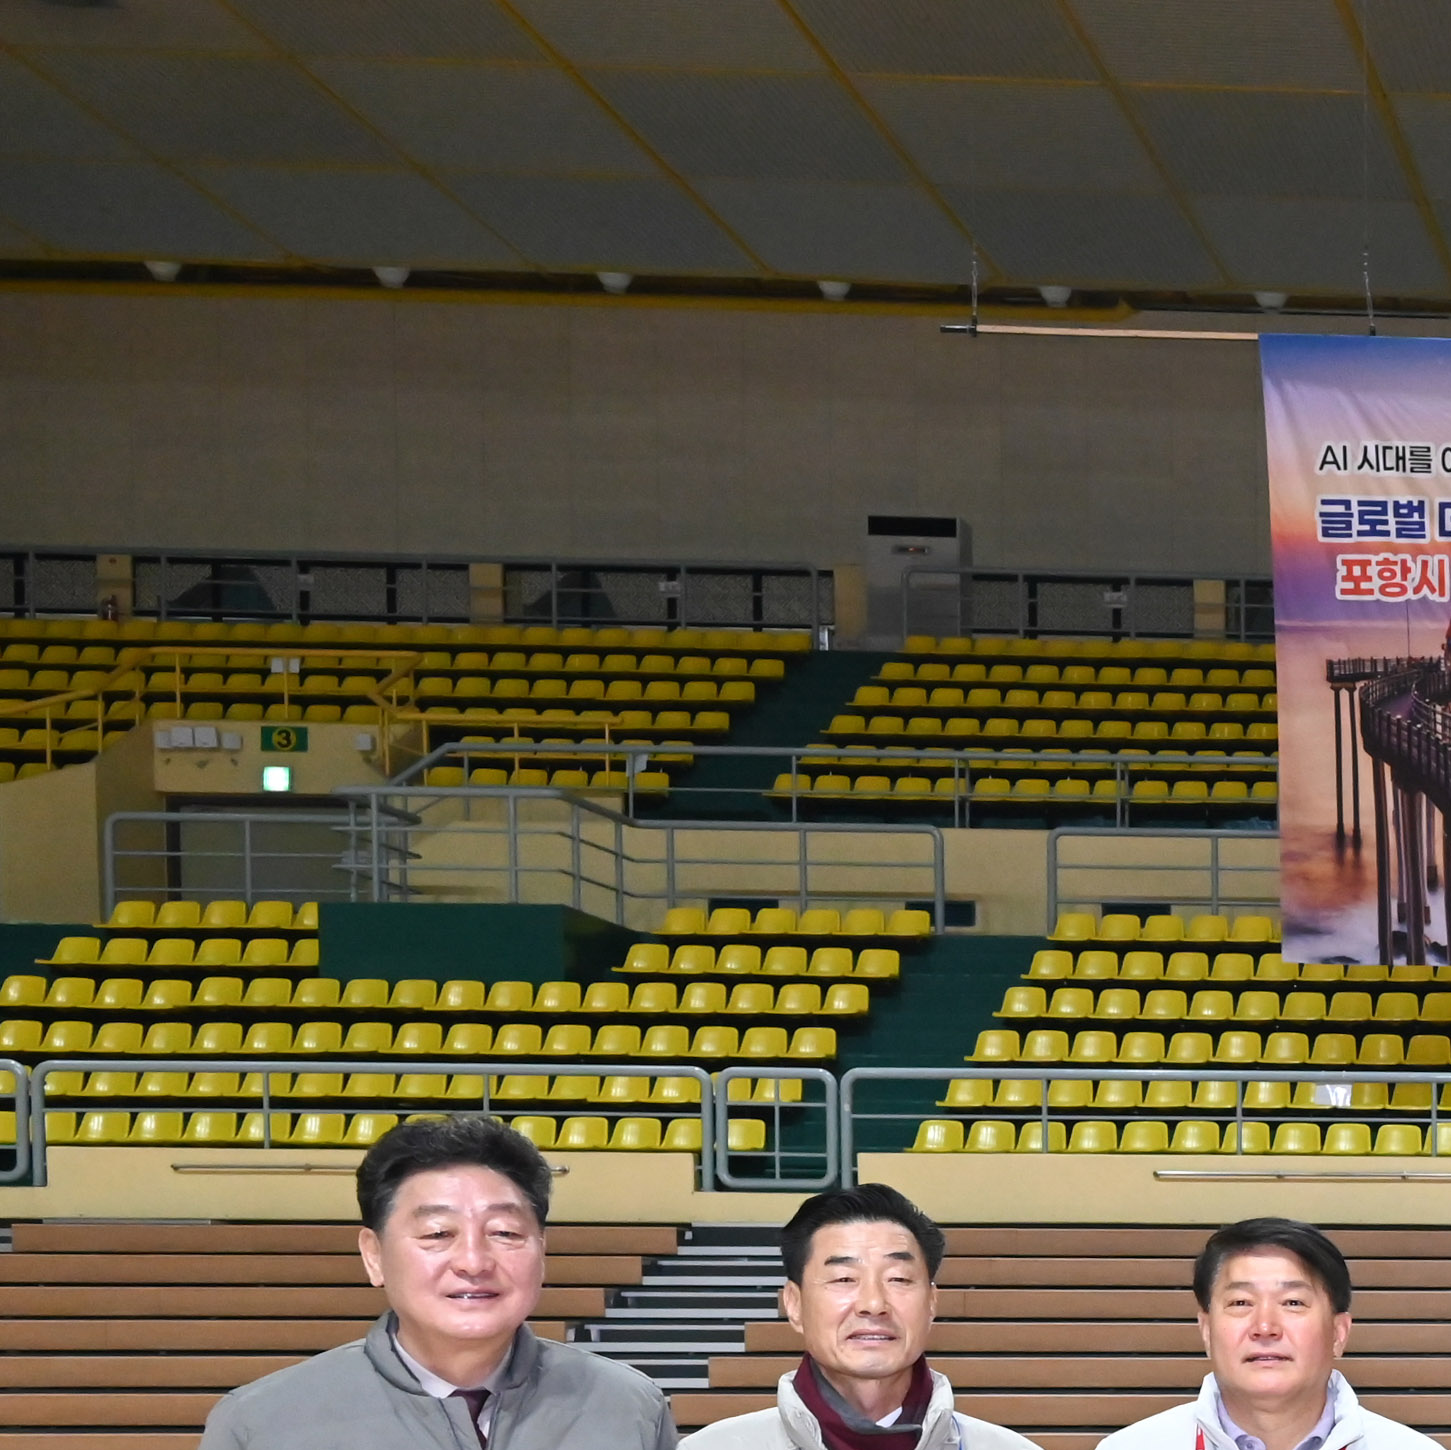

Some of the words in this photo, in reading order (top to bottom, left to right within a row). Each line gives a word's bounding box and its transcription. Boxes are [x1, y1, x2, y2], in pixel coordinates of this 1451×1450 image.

[1319, 445, 1348, 471] AI
[1357, 445, 1433, 474] 시대를
[1318, 499, 1427, 539] 글로벌
[1339, 557, 1446, 599] 포항시
[277, 729, 291, 748] 3
